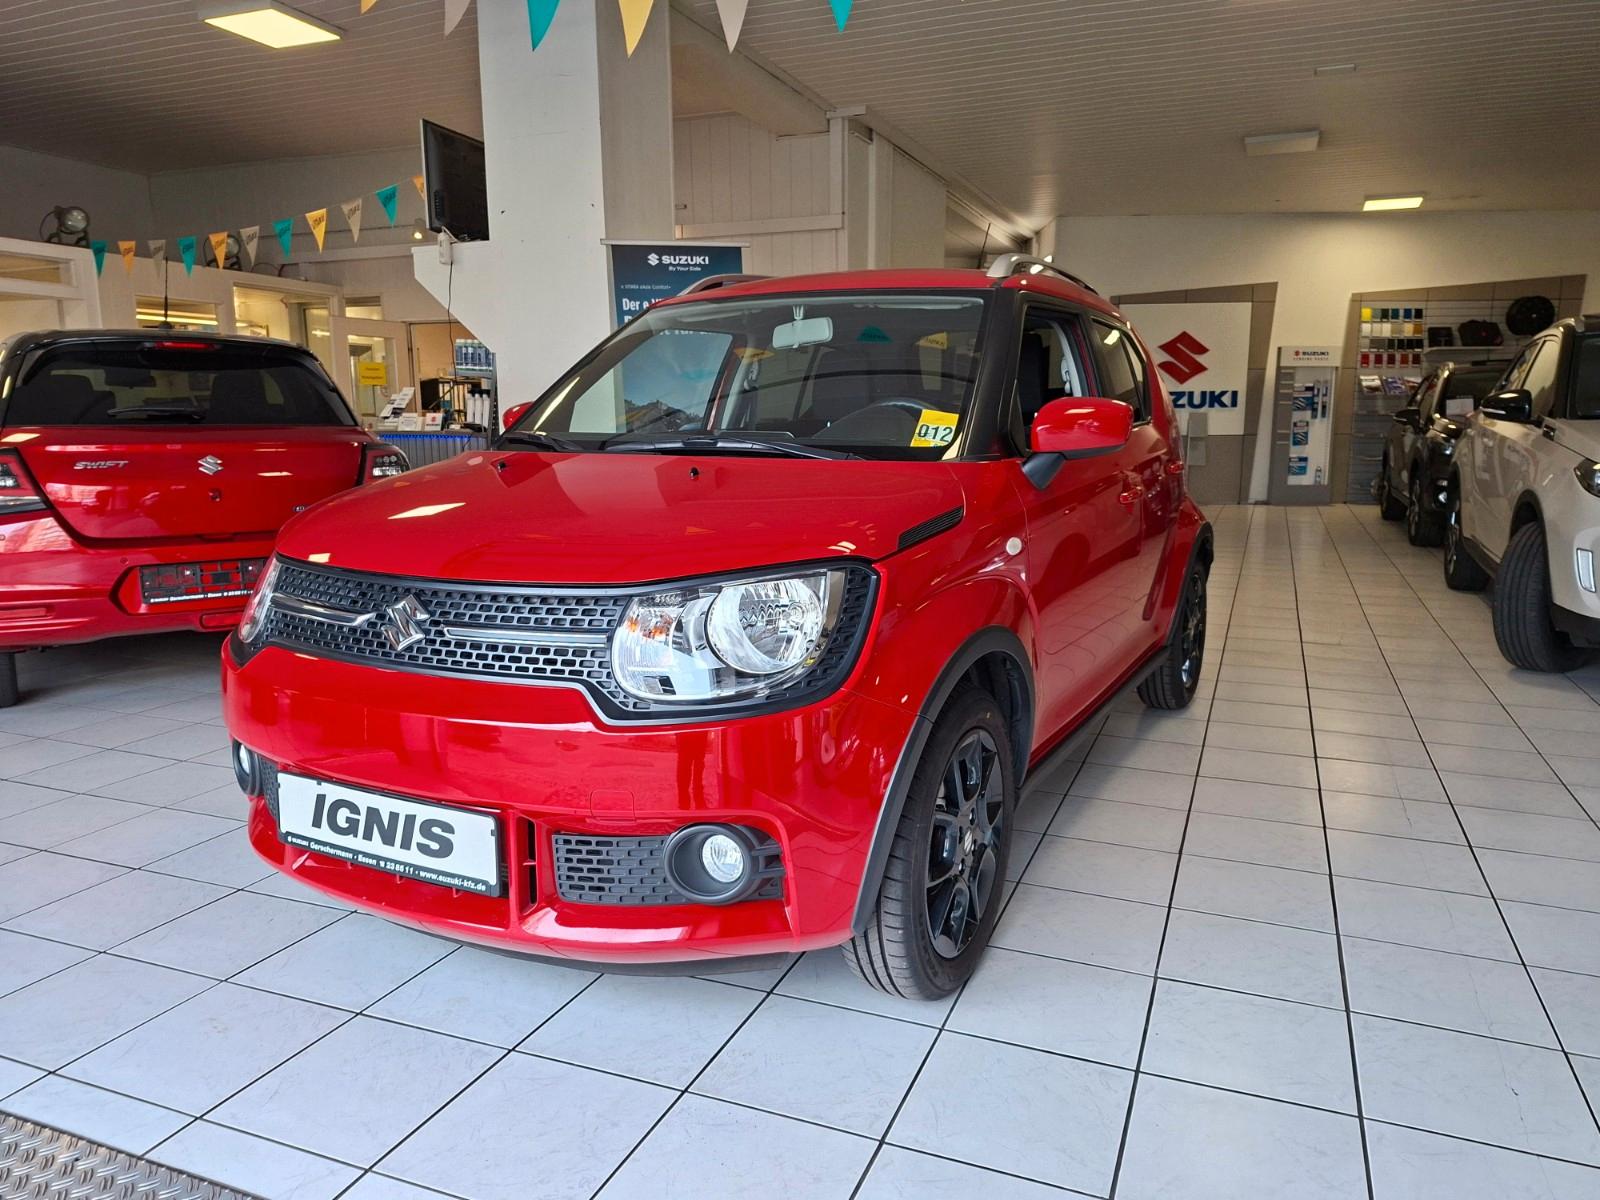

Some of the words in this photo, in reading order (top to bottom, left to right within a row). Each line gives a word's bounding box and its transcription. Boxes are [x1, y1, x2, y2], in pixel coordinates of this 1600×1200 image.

[661, 255, 709, 265] SUZUKI
[622, 298, 640, 311] Der
[1168, 390, 1239, 409] ZUKI
[917, 424, 953, 443] 012
[73, 460, 129, 470] SWIFT
[311, 794, 456, 859] IGNIS
[357, 854, 377, 866] Essen
